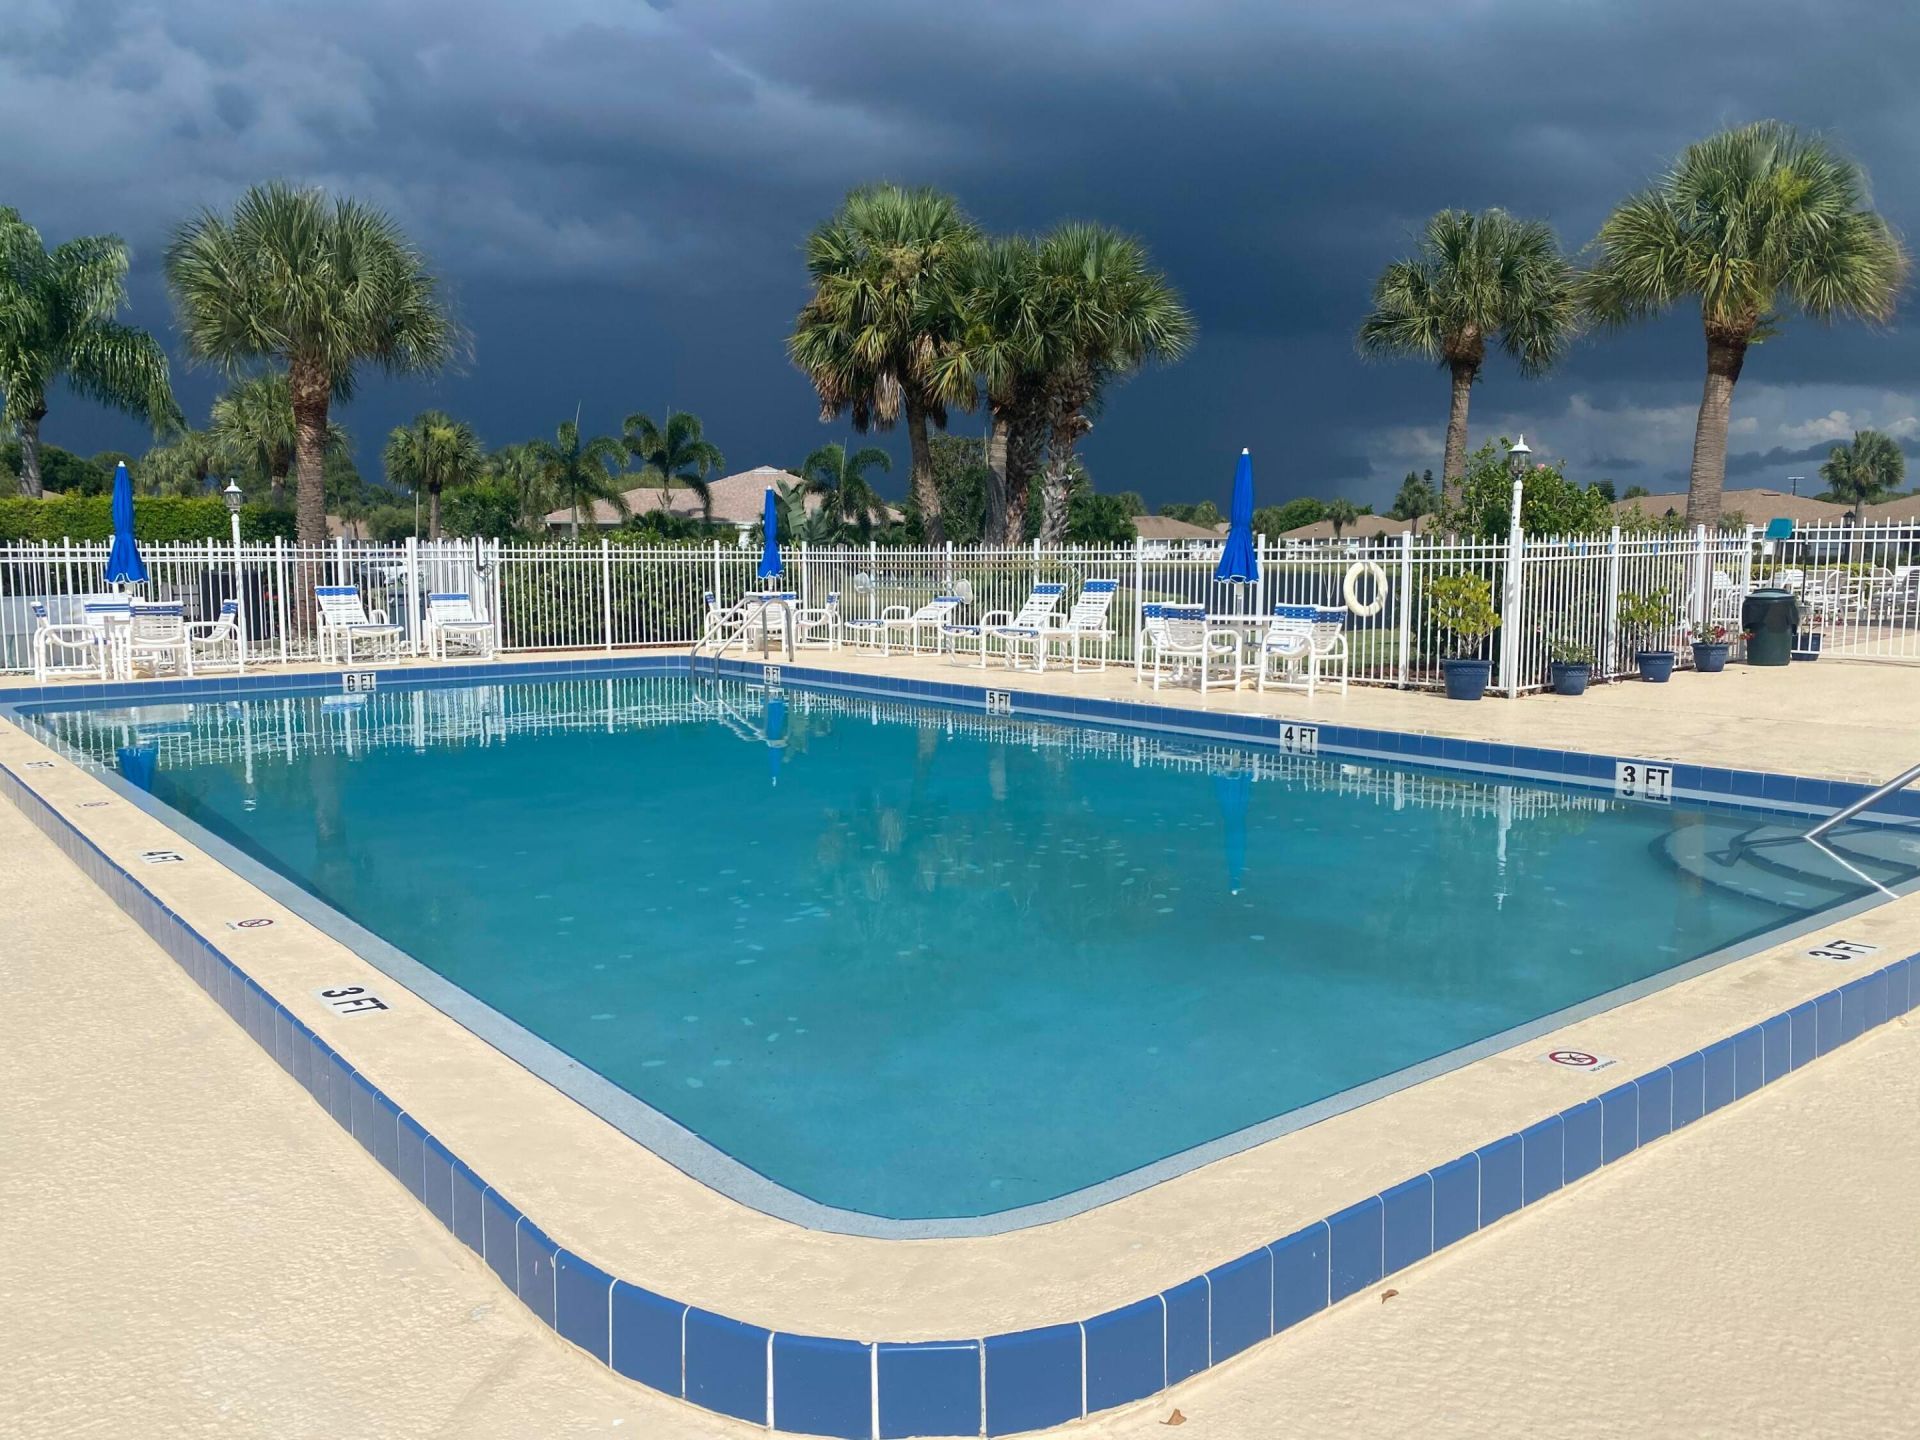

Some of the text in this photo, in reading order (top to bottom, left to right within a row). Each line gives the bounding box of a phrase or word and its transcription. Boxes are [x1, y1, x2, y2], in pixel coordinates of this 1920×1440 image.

[989, 692, 1009, 705] 5 FT
[1284, 726, 1316, 743] 4 FT
[1623, 765, 1669, 786] 3 FT
[147, 855, 184, 863] FT
[1808, 939, 1878, 960] 3 FT
[321, 987, 389, 1013] 3 FT
